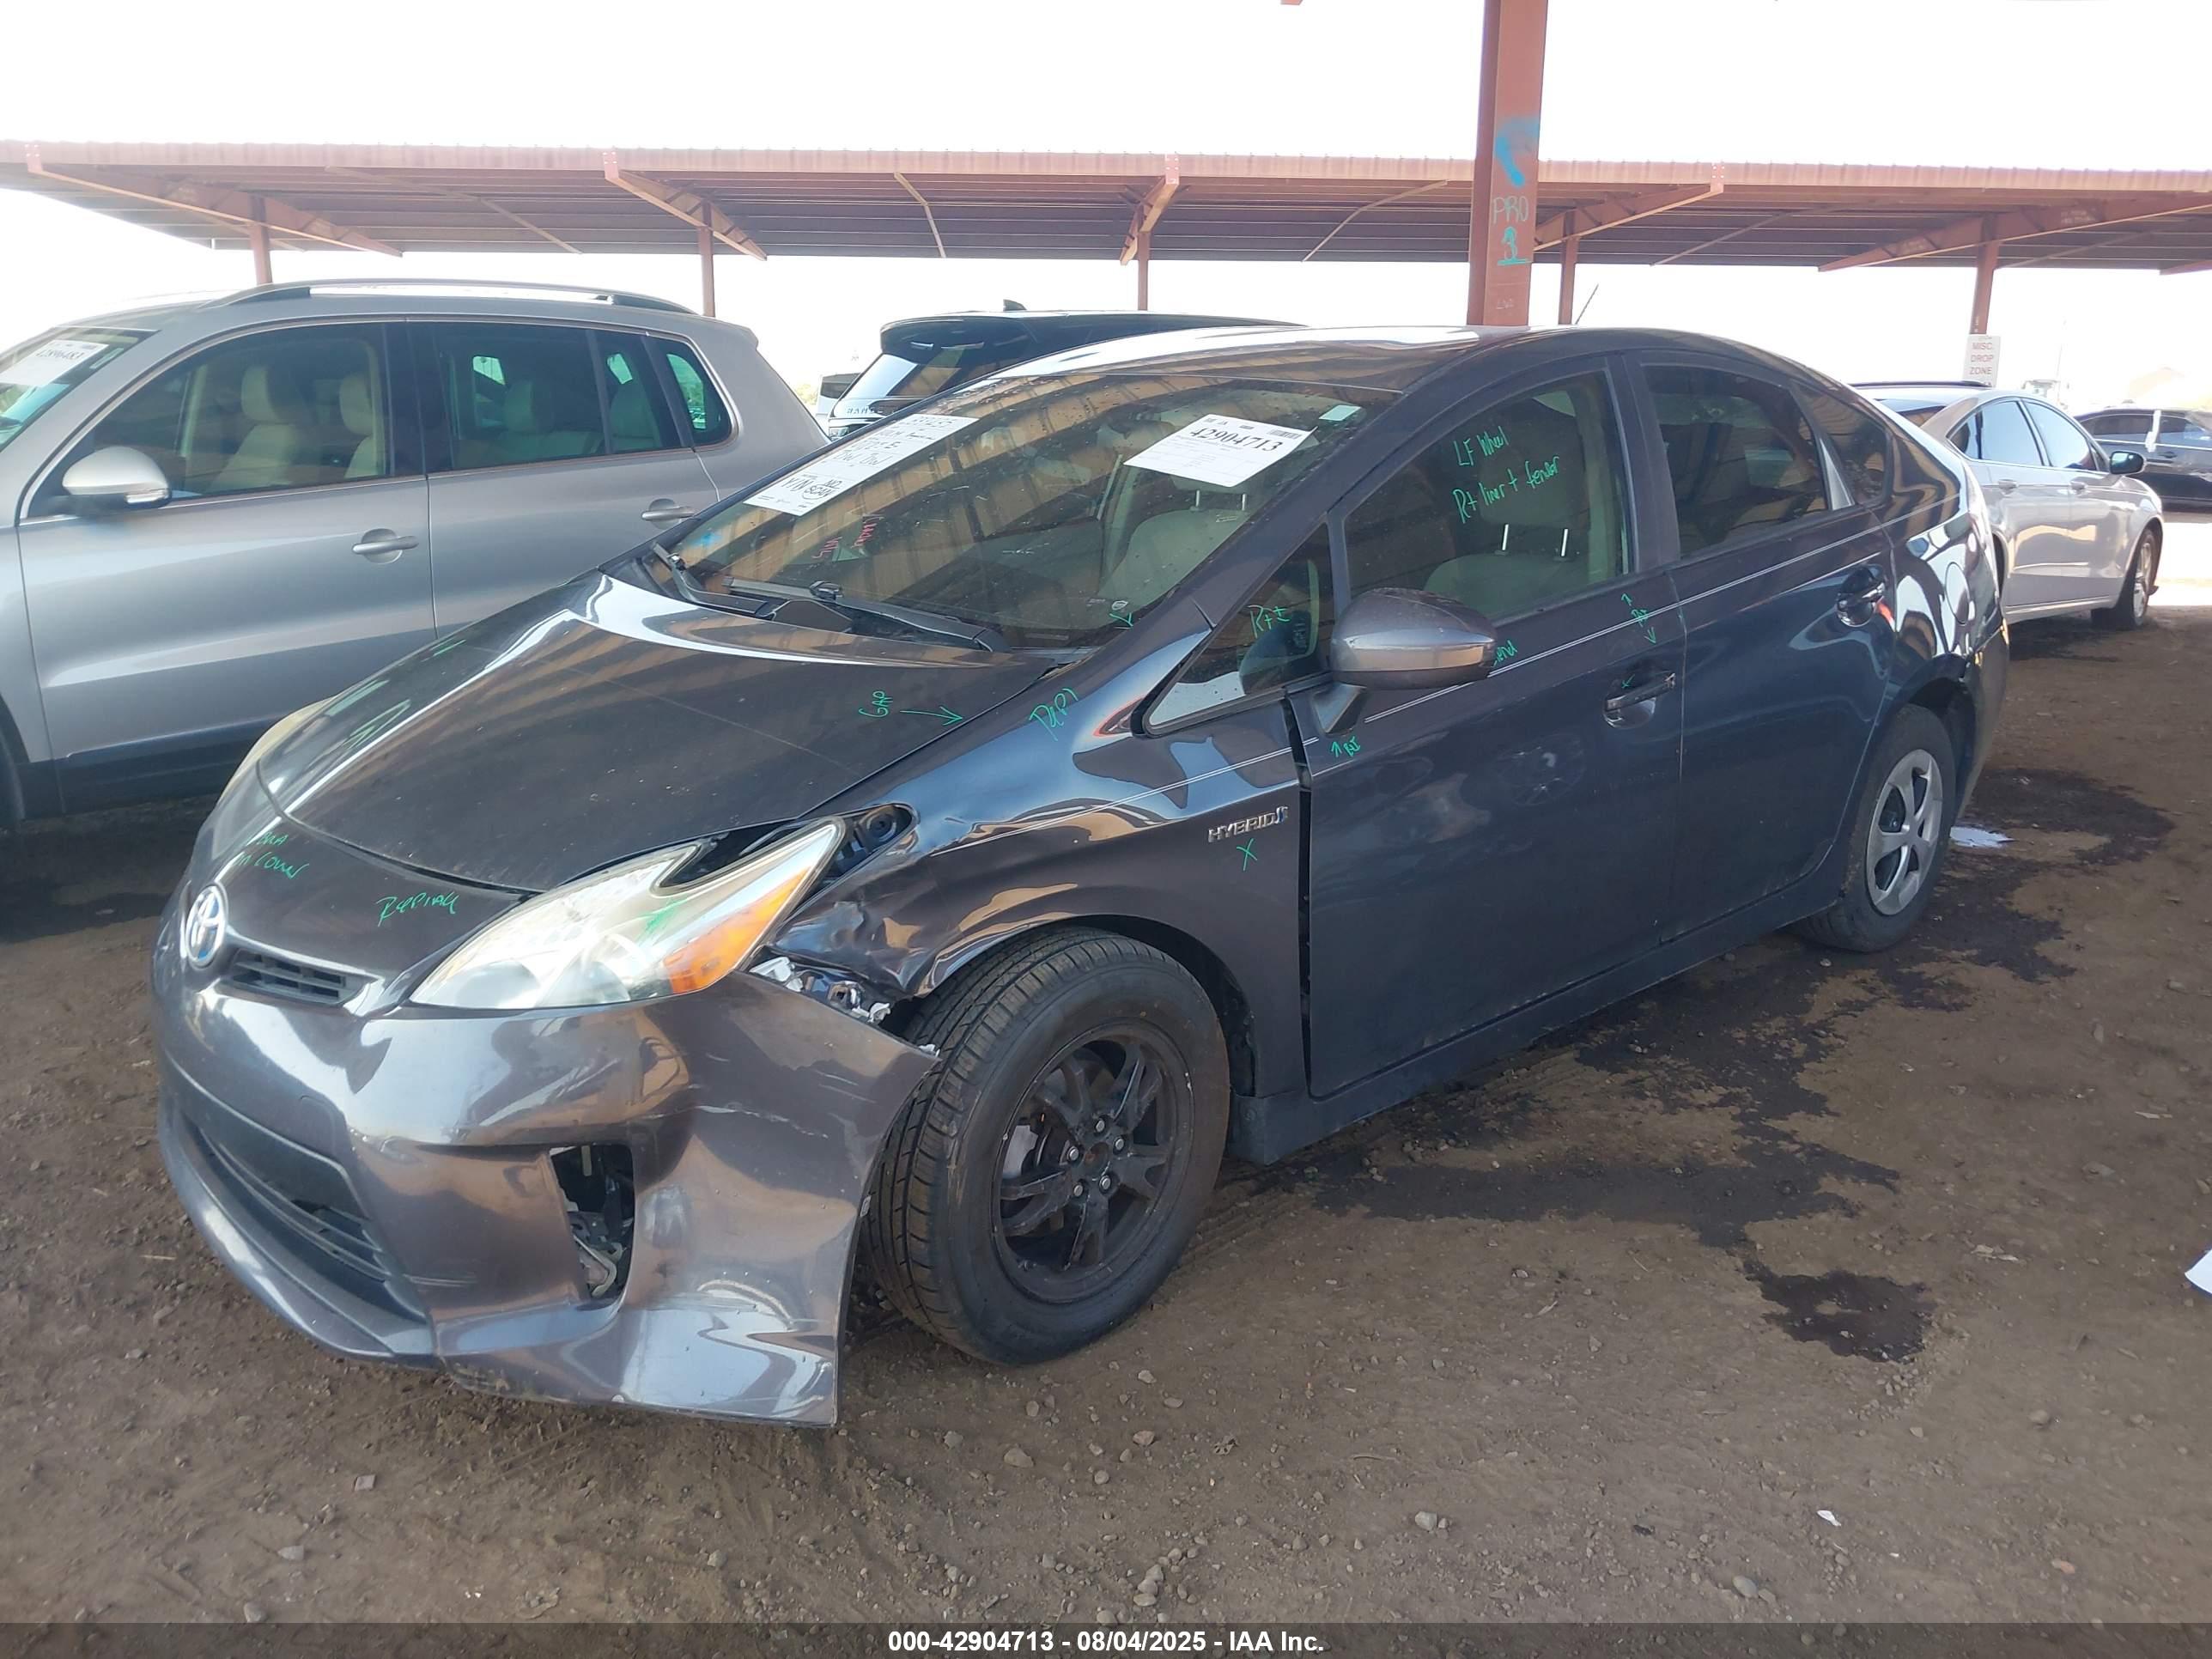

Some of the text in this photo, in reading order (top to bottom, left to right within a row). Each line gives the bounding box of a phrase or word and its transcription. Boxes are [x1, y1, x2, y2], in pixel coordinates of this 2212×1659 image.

[1971, 354, 1994, 362] DROP
[1970, 367, 1993, 375] ZONE
[1189, 427, 1283, 452] 42904713
[1453, 438, 1474, 466] LF
[859, 690, 893, 718] GAP
